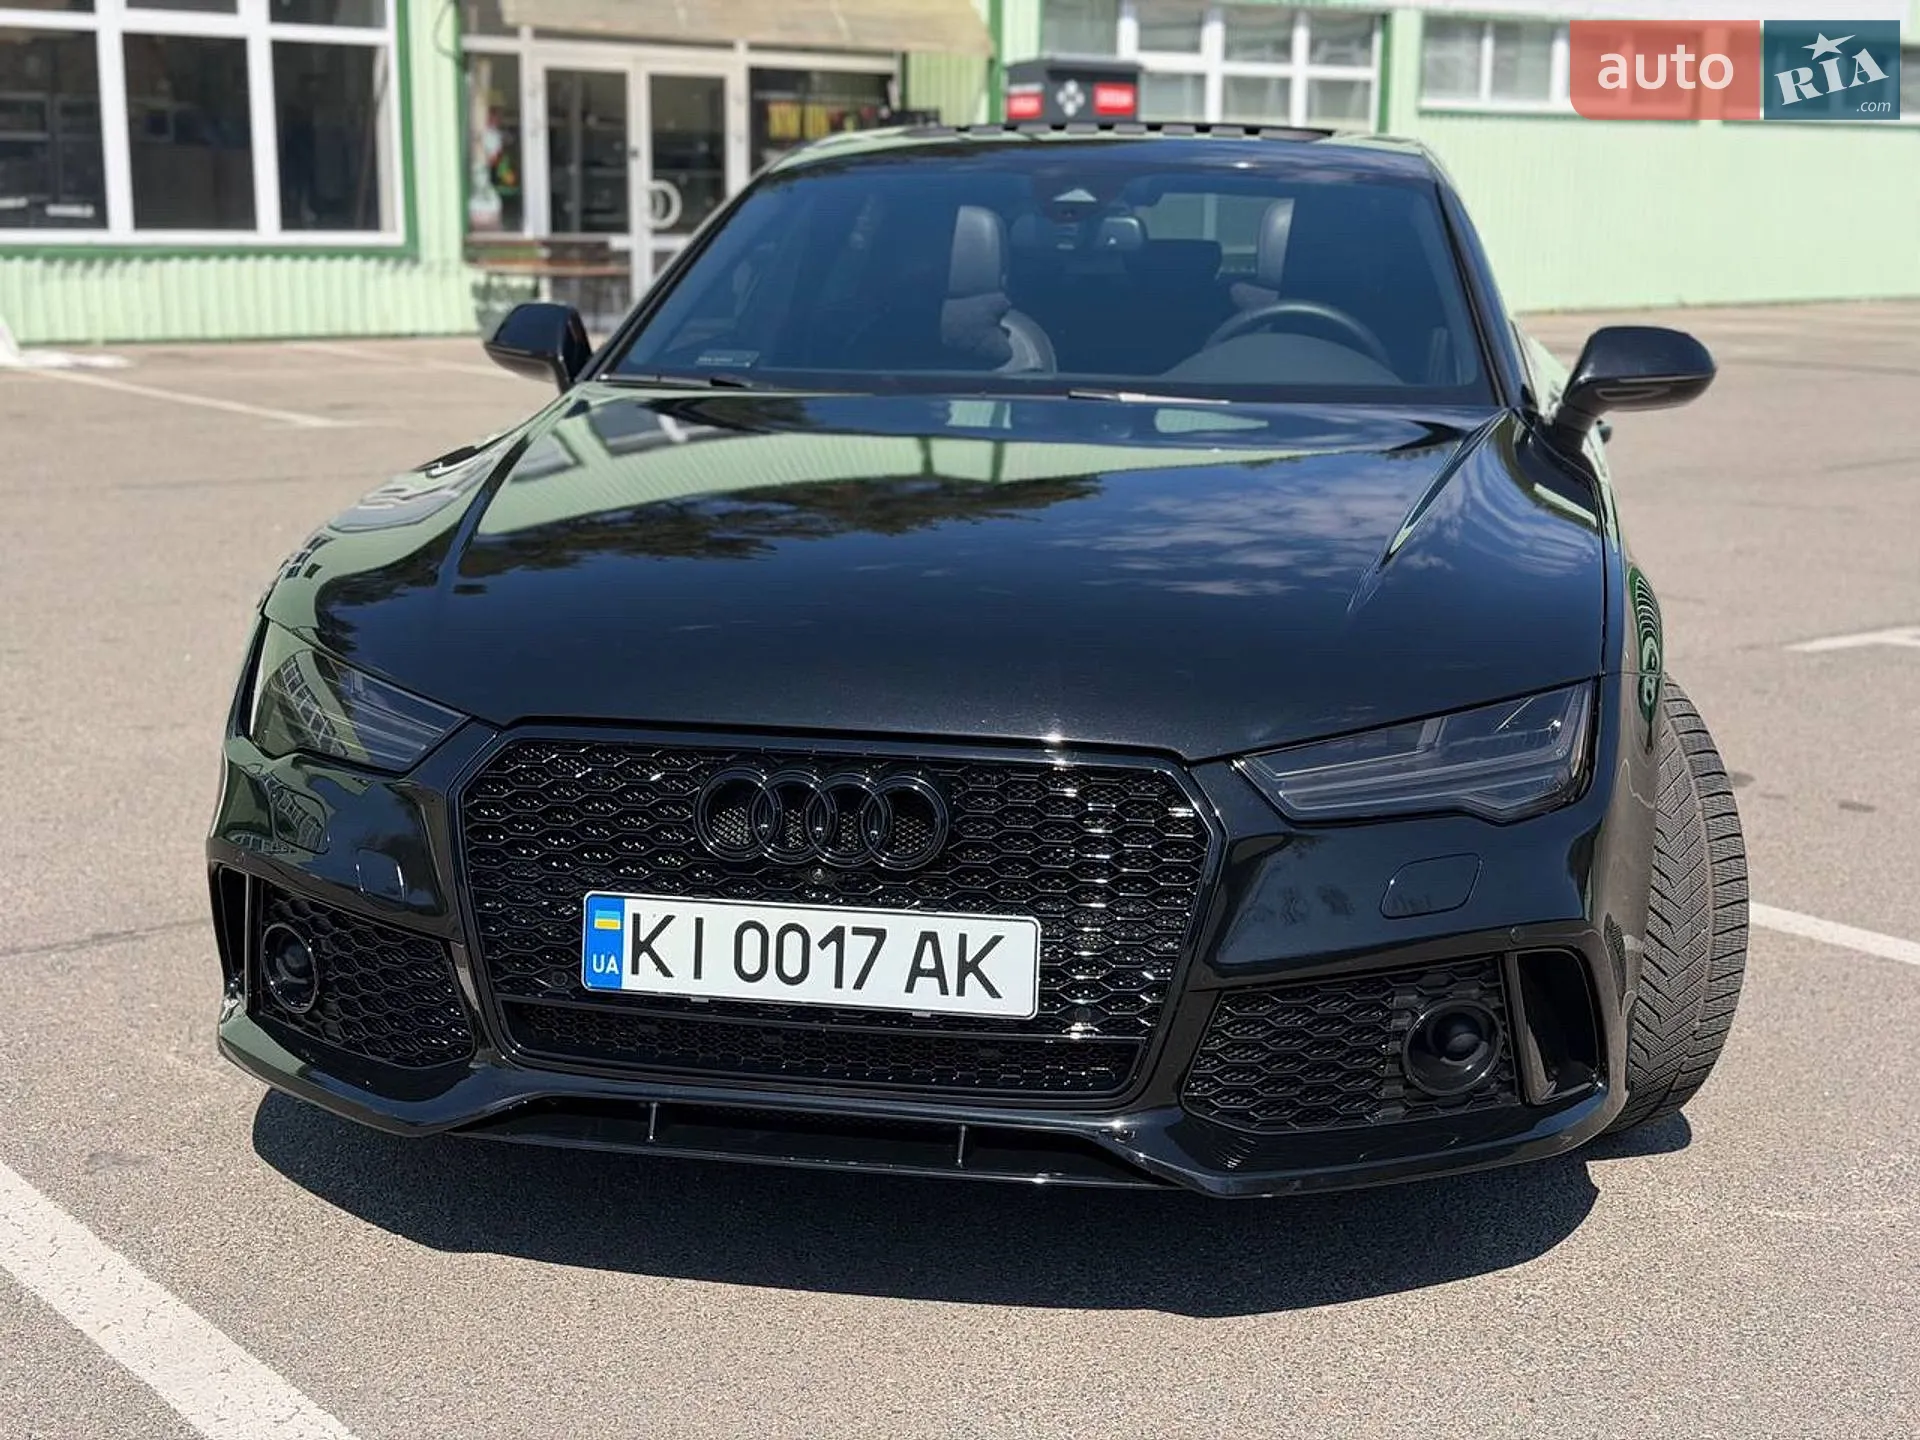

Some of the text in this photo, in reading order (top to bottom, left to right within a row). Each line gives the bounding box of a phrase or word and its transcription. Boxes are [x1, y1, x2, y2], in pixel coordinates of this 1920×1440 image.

[592, 953, 620, 975] UA
[631, 912, 1005, 999] KI 0017 AK
